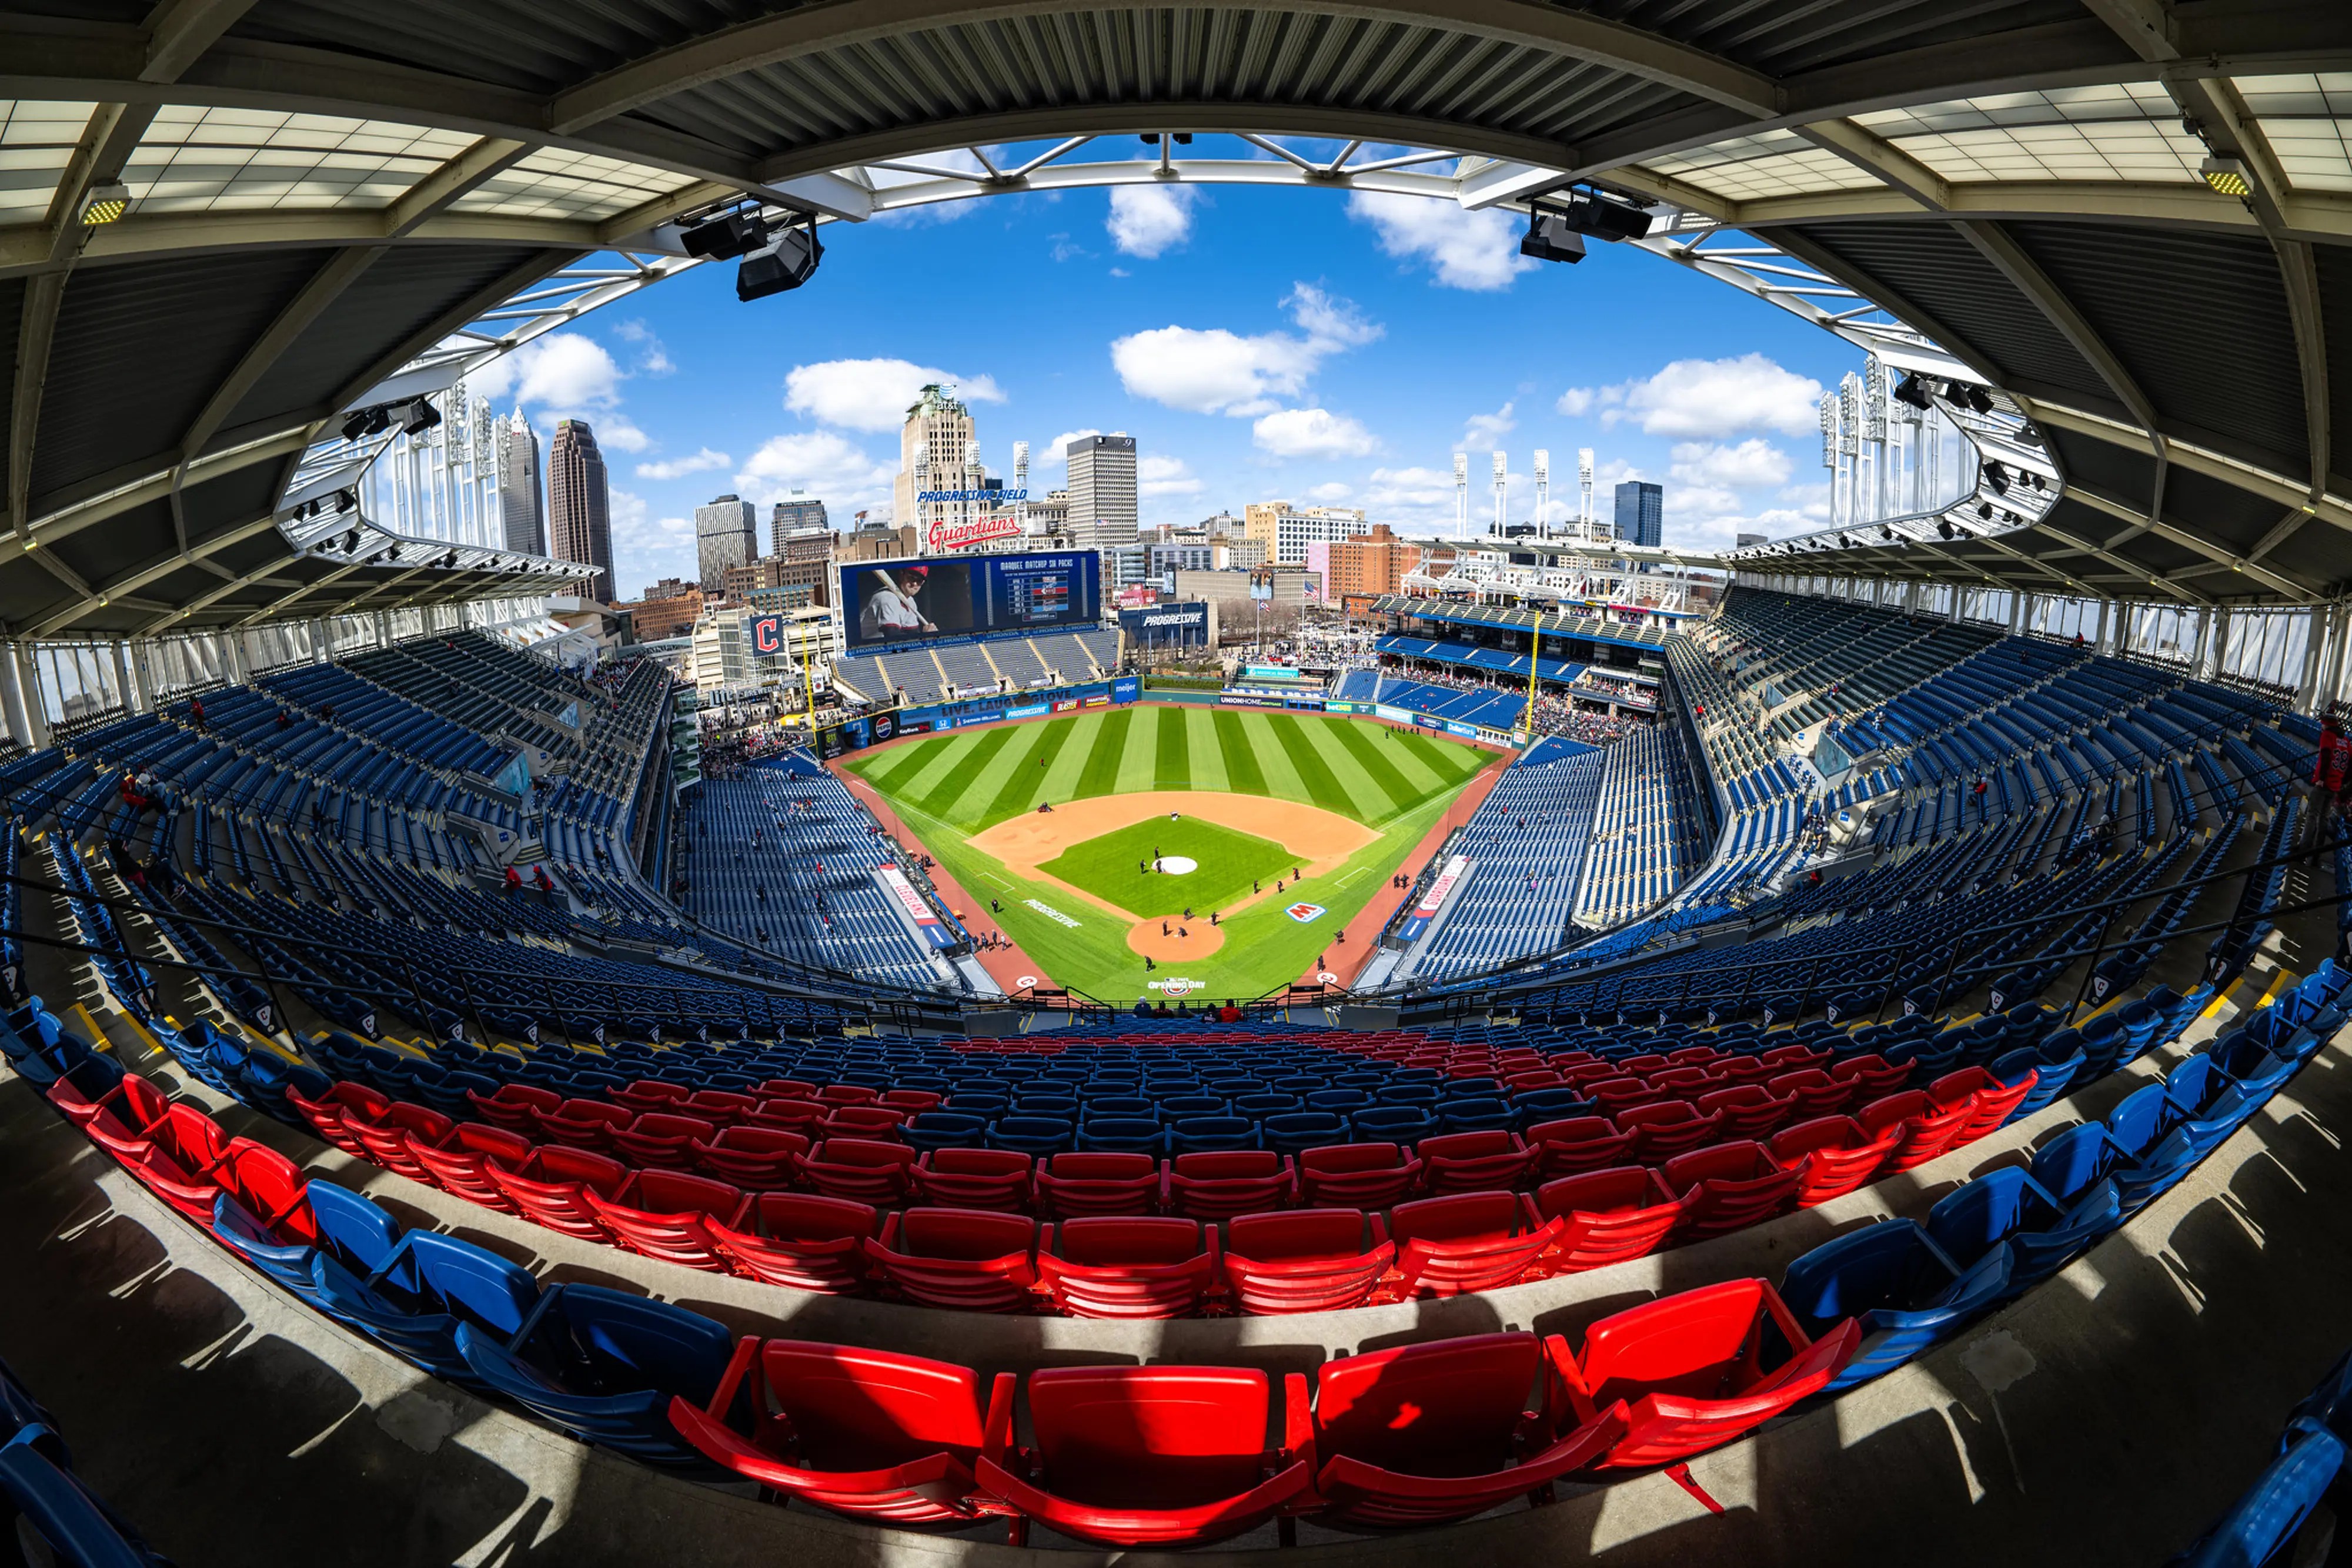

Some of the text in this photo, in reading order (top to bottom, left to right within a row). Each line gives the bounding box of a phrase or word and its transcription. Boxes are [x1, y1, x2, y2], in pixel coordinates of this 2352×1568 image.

[937, 401, 958, 410] at&t
[917, 489, 1028, 502] PROGRESSIVE FIELD
[928, 516, 1021, 551] Guardians
[1144, 613, 1202, 627] PROGRESSIVE
[756, 618, 779, 653] C
[943, 636, 972, 644] HONDA
[856, 646, 886, 654] HONDA
[1116, 683, 1136, 693] meijer
[942, 704, 974, 717] LIVE.
[1031, 690, 1075, 703] GLOVE.
[1327, 703, 1351, 711] bet365
[1007, 706, 1047, 718] PROGRESSIVE
[877, 723, 891, 731] PEPSI
[899, 726, 919, 734] KeyBank
[1424, 874, 1455, 906] GUARDIANS
[896, 884, 928, 916] CLEVELAND
[1148, 980, 1206, 989] OPENING DAY
